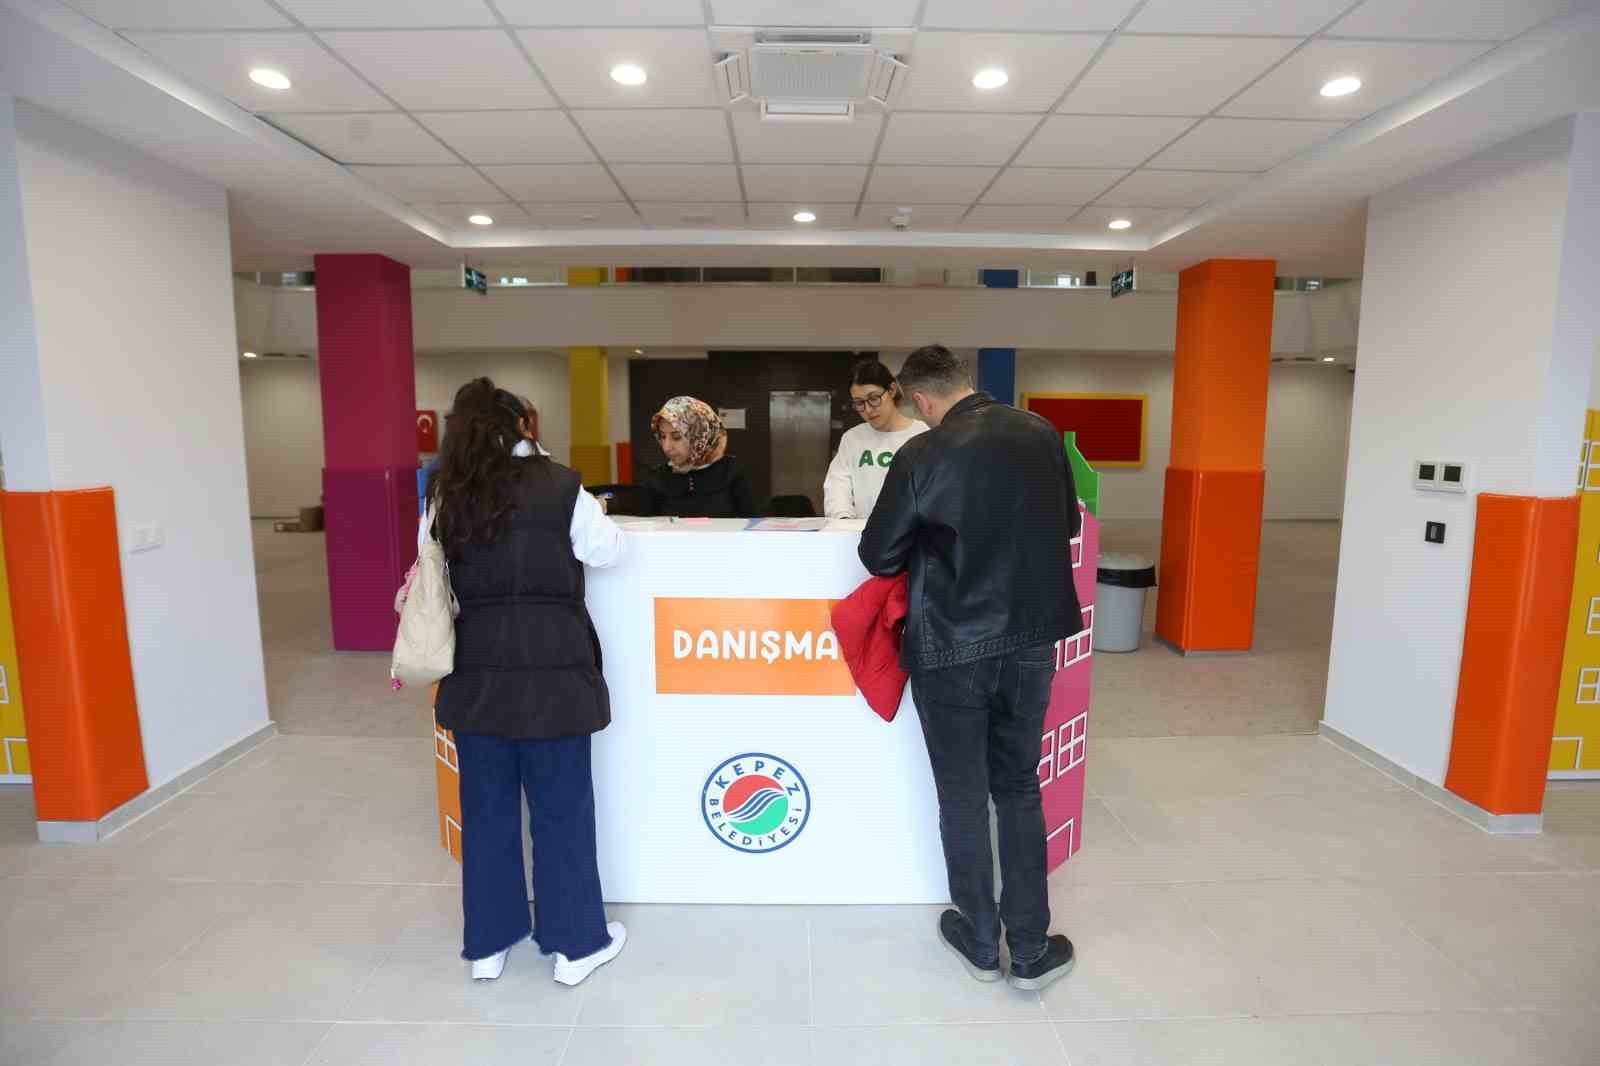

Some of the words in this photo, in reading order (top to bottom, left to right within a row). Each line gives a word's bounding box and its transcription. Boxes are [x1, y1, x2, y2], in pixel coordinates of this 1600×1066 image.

[673, 629, 839, 664] DANIŞMA
[714, 760, 801, 797] KEPEZ
[709, 798, 802, 846] BELEDİYESİ
